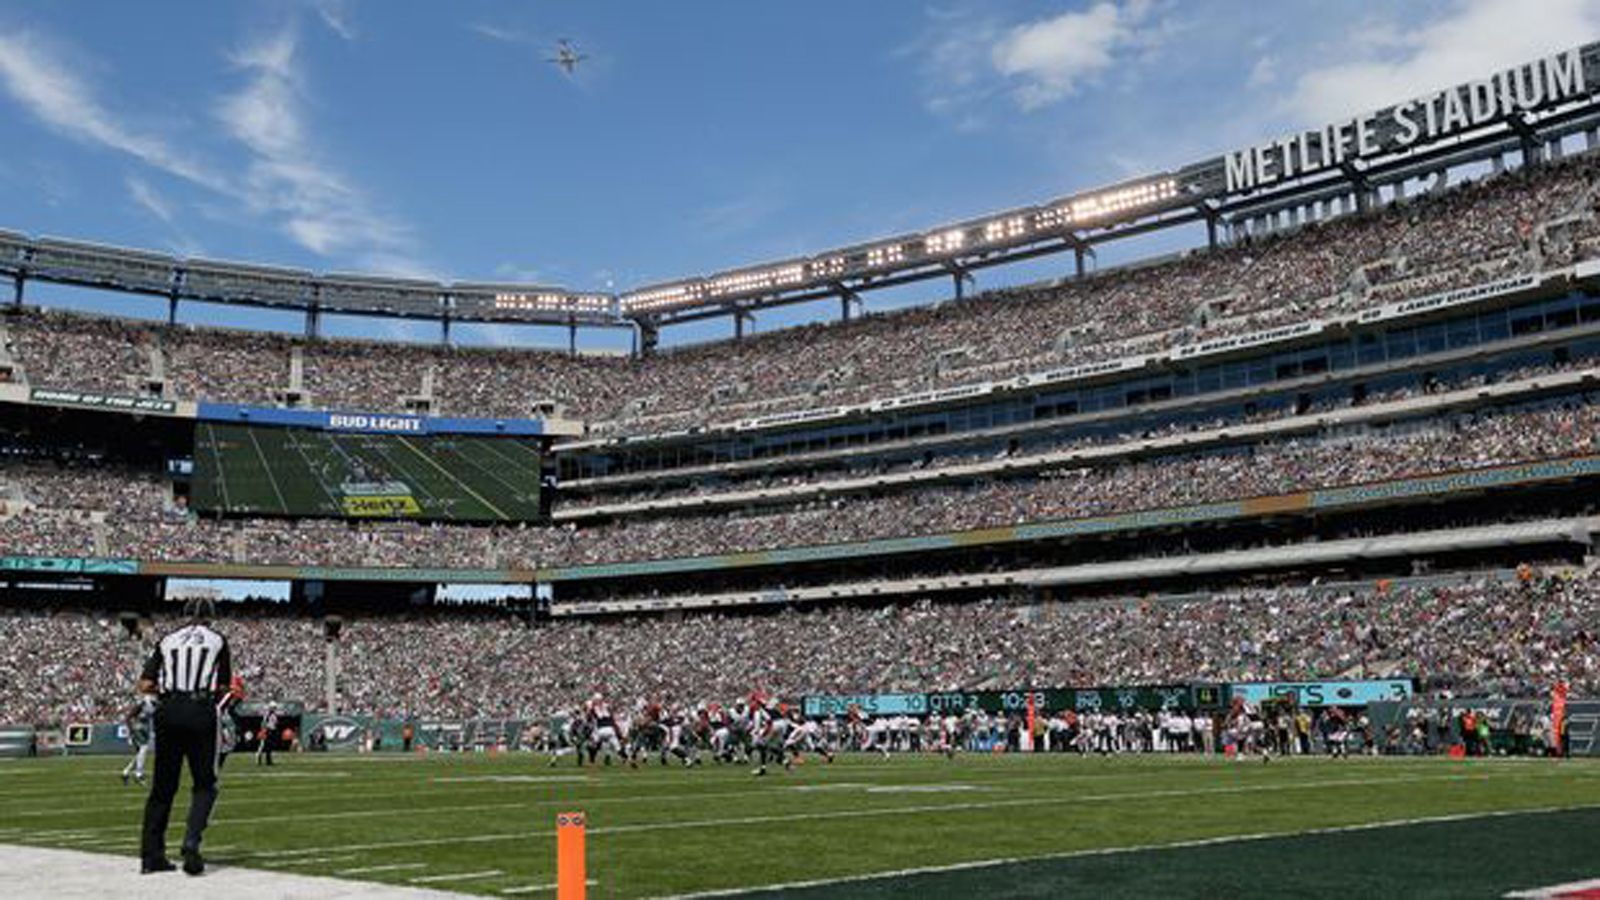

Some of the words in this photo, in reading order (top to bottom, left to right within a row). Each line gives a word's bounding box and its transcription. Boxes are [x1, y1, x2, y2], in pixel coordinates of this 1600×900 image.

[1224, 116, 1381, 193] METLIFE
[1393, 47, 1586, 146] STADIUM
[330, 414, 367, 428] BUD
[370, 416, 421, 431] LIGHT
[929, 695, 963, 710] QTR
